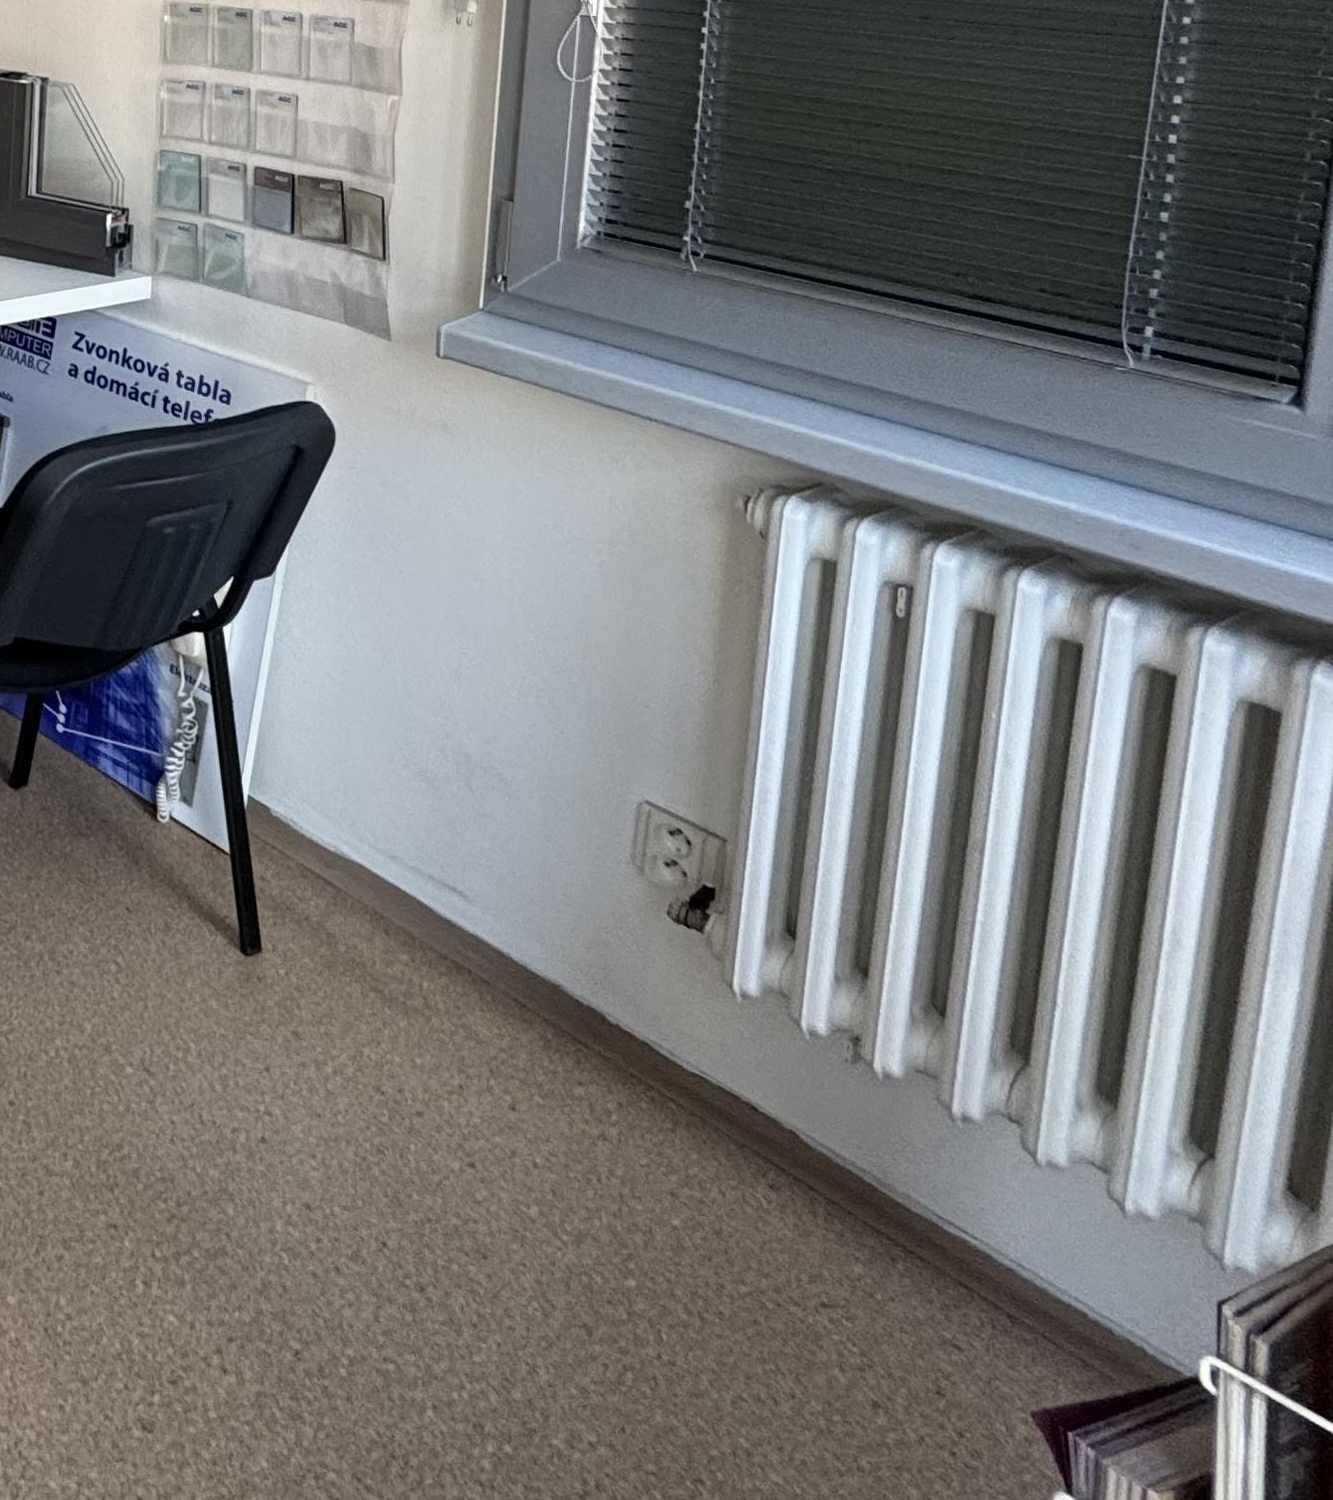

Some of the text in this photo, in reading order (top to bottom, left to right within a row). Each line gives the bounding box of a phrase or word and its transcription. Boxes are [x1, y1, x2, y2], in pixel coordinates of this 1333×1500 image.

[67, 361, 79, 379] a
[83, 365, 159, 409] domácí
[71, 331, 232, 406] Zvonková tabla
